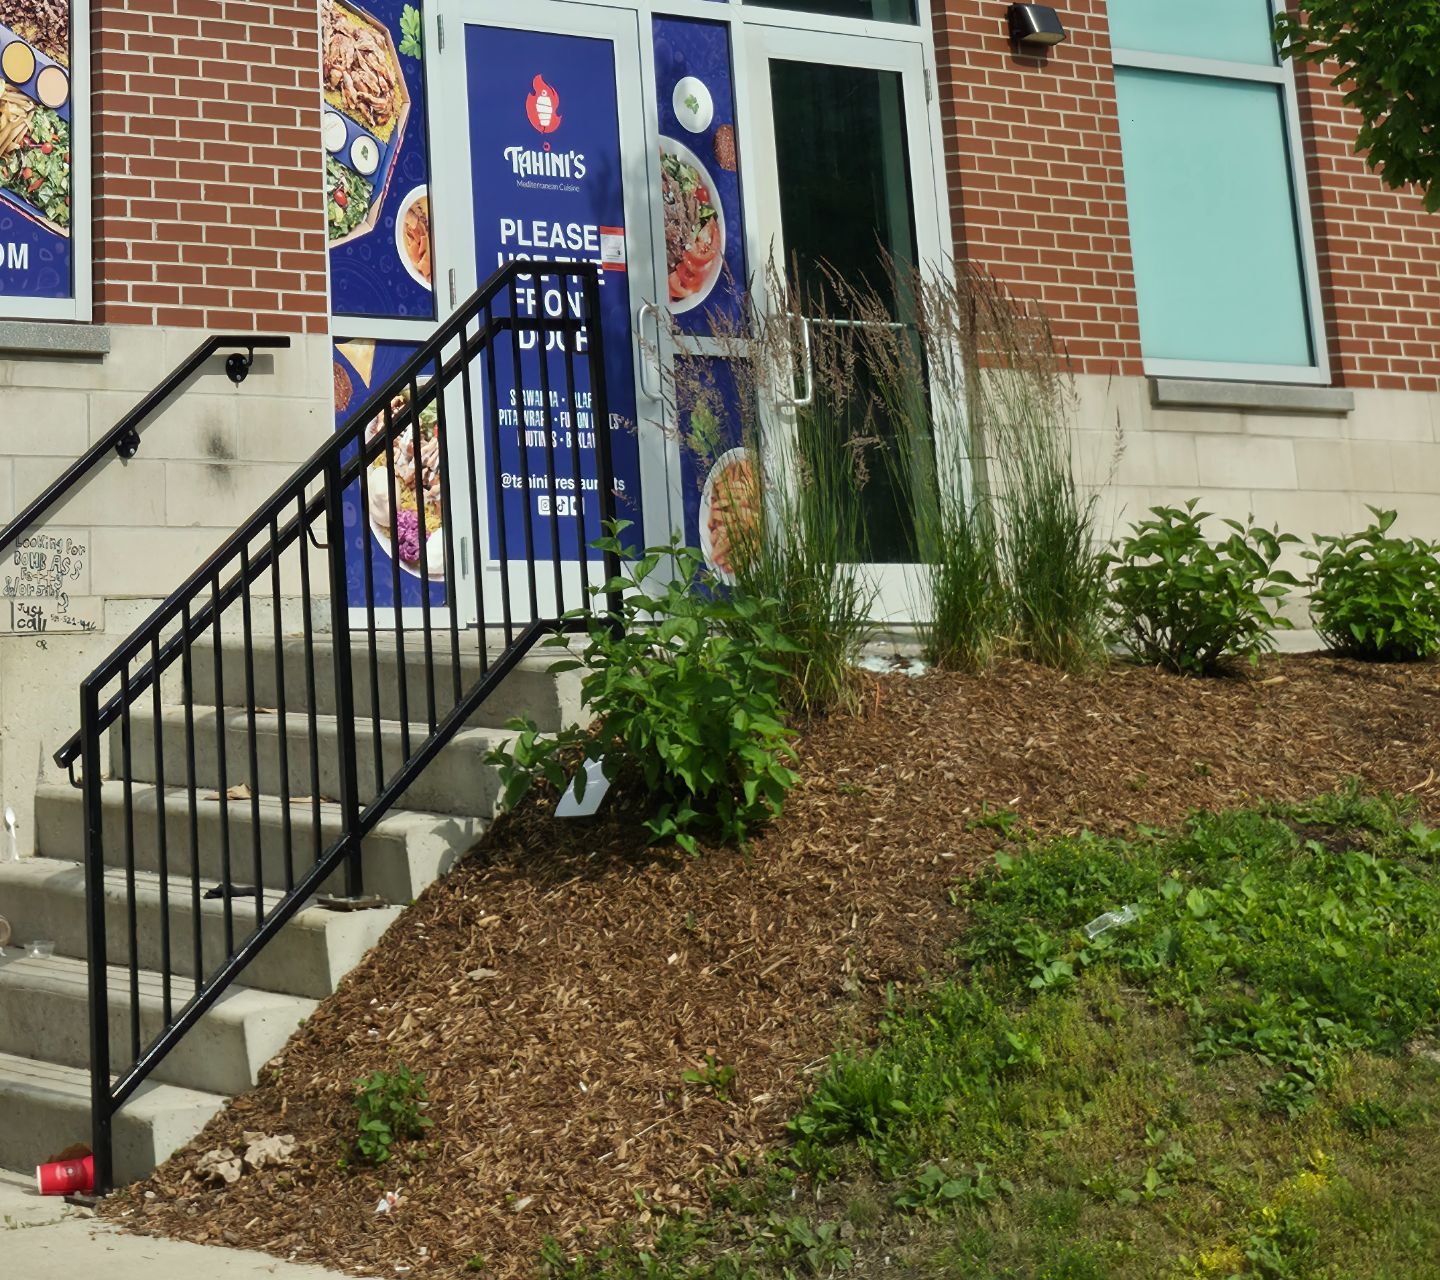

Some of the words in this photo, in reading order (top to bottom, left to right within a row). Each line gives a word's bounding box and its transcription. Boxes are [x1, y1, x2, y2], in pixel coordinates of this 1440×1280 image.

[516, 180, 559, 191] Mediterranean
[559, 183, 580, 193] Cuisine
[500, 218, 599, 252] PLEASE
[513, 288, 588, 318] FRON
[499, 408, 519, 426] PITA
[522, 410, 548, 428] WRAP
[560, 411, 590, 429] FUON
